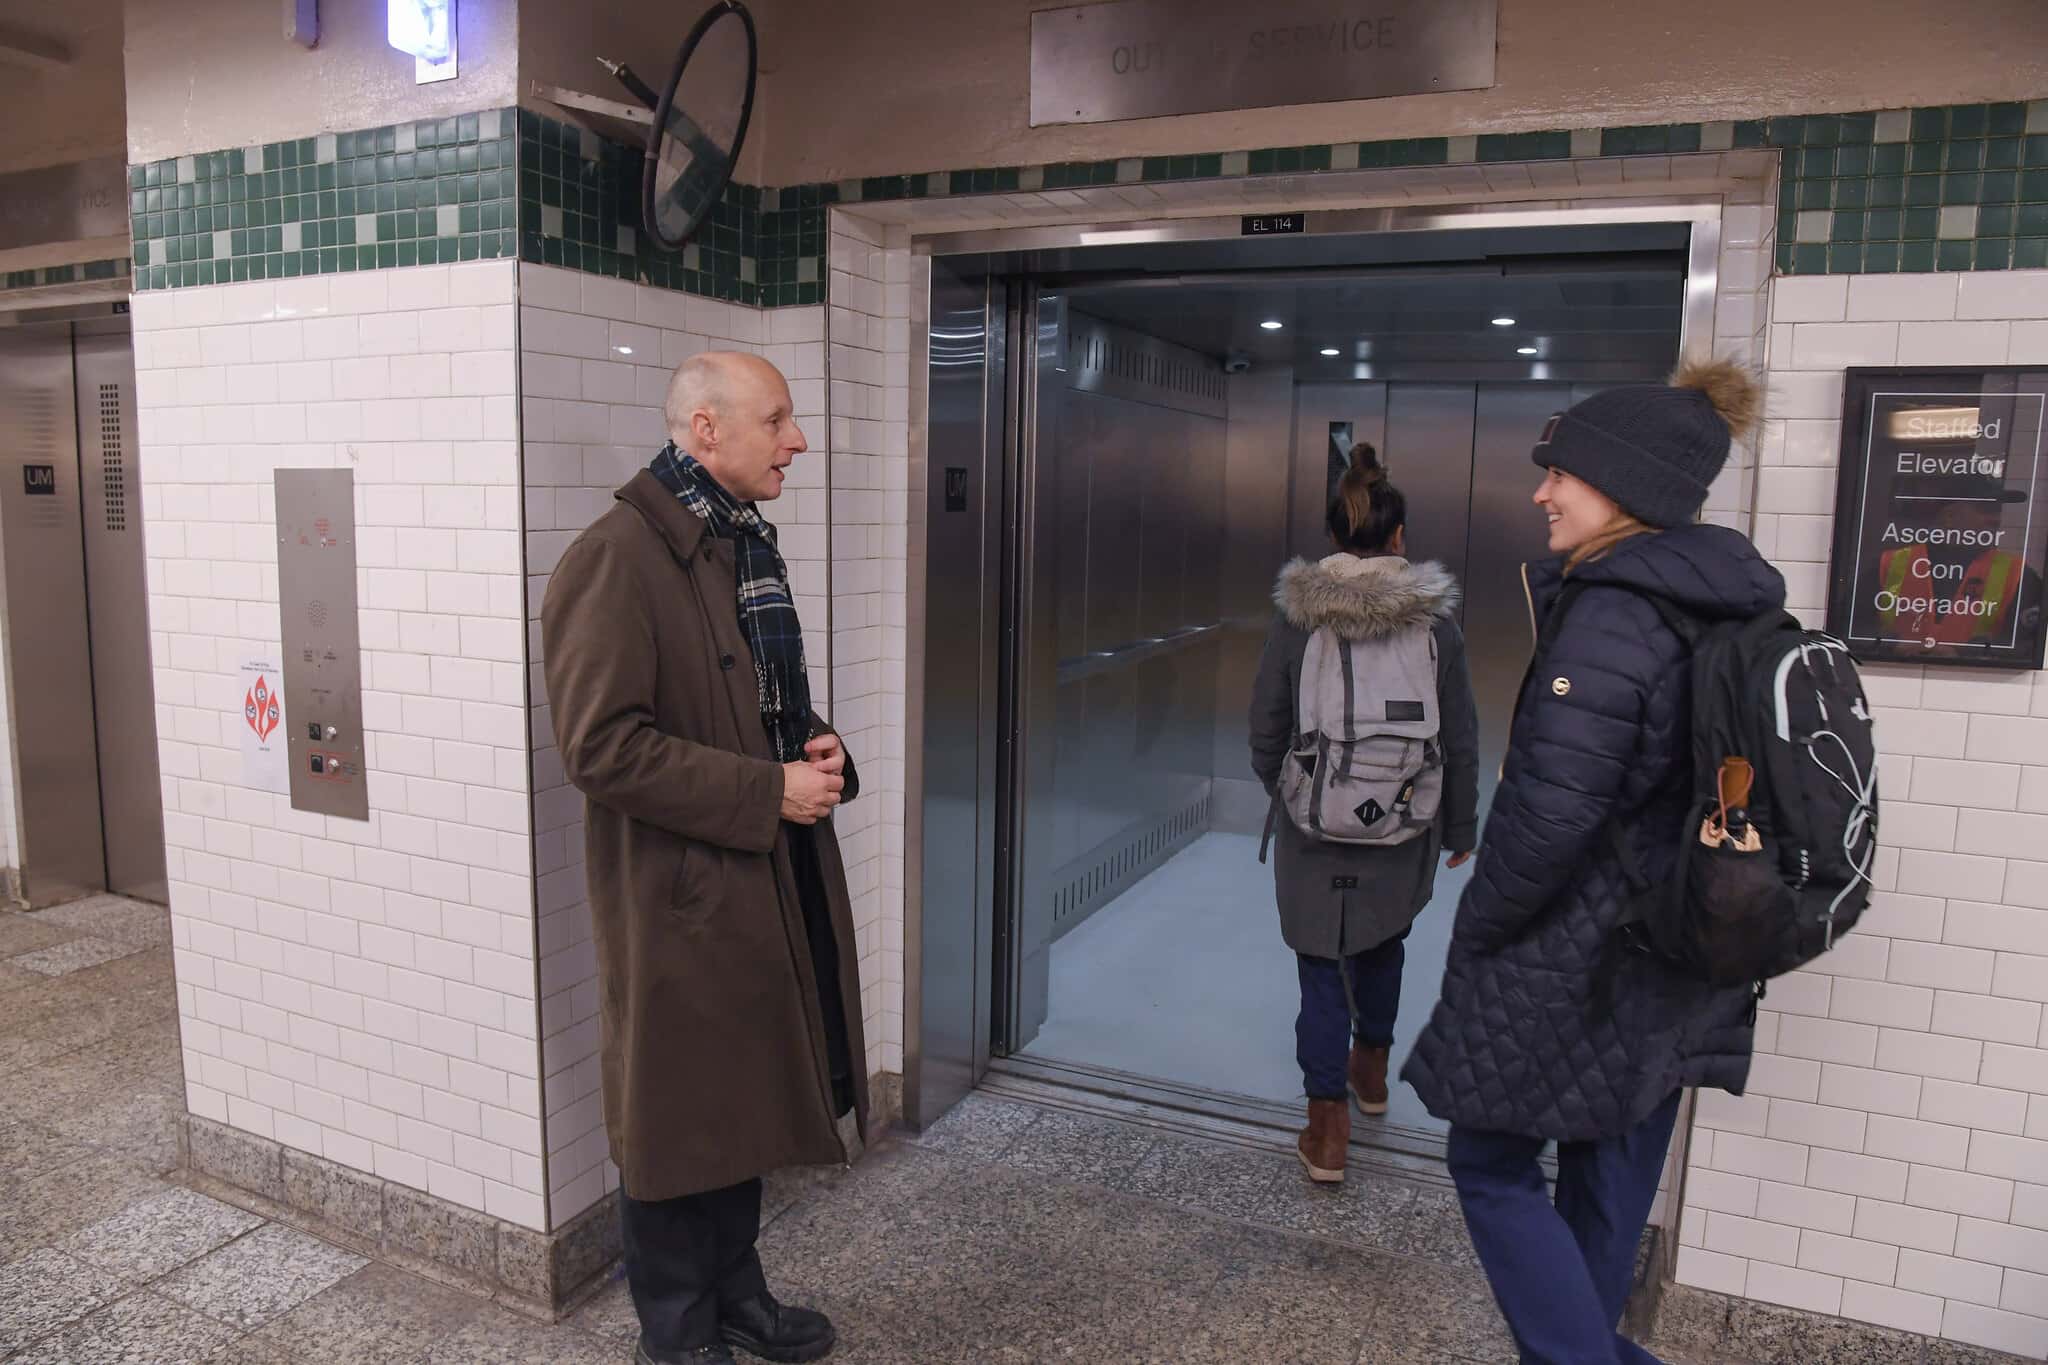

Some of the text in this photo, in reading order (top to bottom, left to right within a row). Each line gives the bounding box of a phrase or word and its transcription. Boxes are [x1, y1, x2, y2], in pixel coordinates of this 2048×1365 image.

[1248, 16, 1397, 61] SERVICE
[1253, 217, 1292, 232] EL 114
[1907, 417, 2001, 440] Staffed
[1897, 452, 2006, 475] Elevator
[27, 467, 52, 486] UM
[1881, 522, 2006, 547] Ascensor
[1911, 558, 1964, 580] Con
[1873, 591, 1999, 618] Operador
